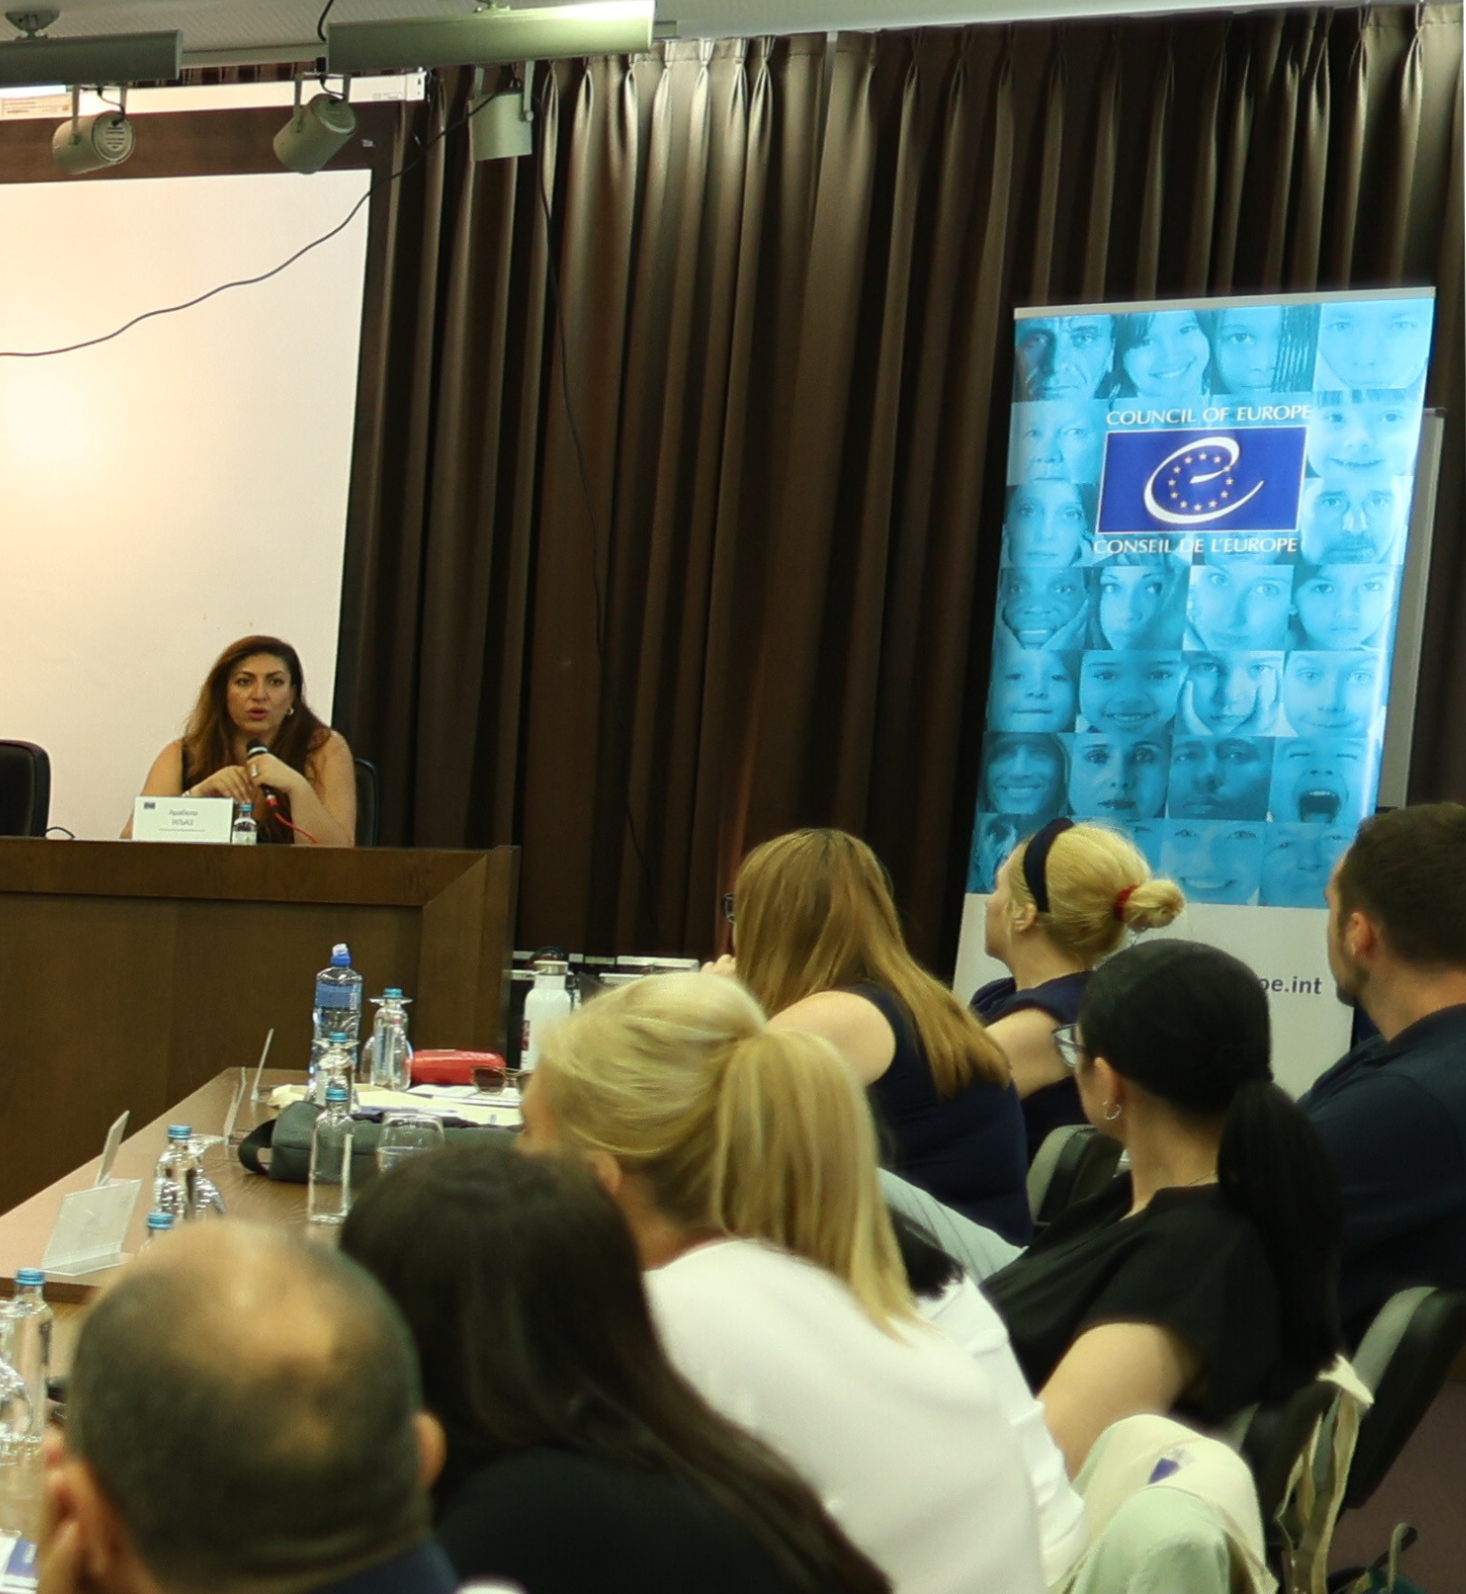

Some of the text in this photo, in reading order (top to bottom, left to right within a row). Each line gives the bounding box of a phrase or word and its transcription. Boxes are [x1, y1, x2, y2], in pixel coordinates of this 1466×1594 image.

[1105, 405, 1312, 425] COUNCIL OF EUROPE
[1094, 537, 1298, 555] CONSEIL DE L'EUROPE
[1258, 975, 1323, 995] oe.int
